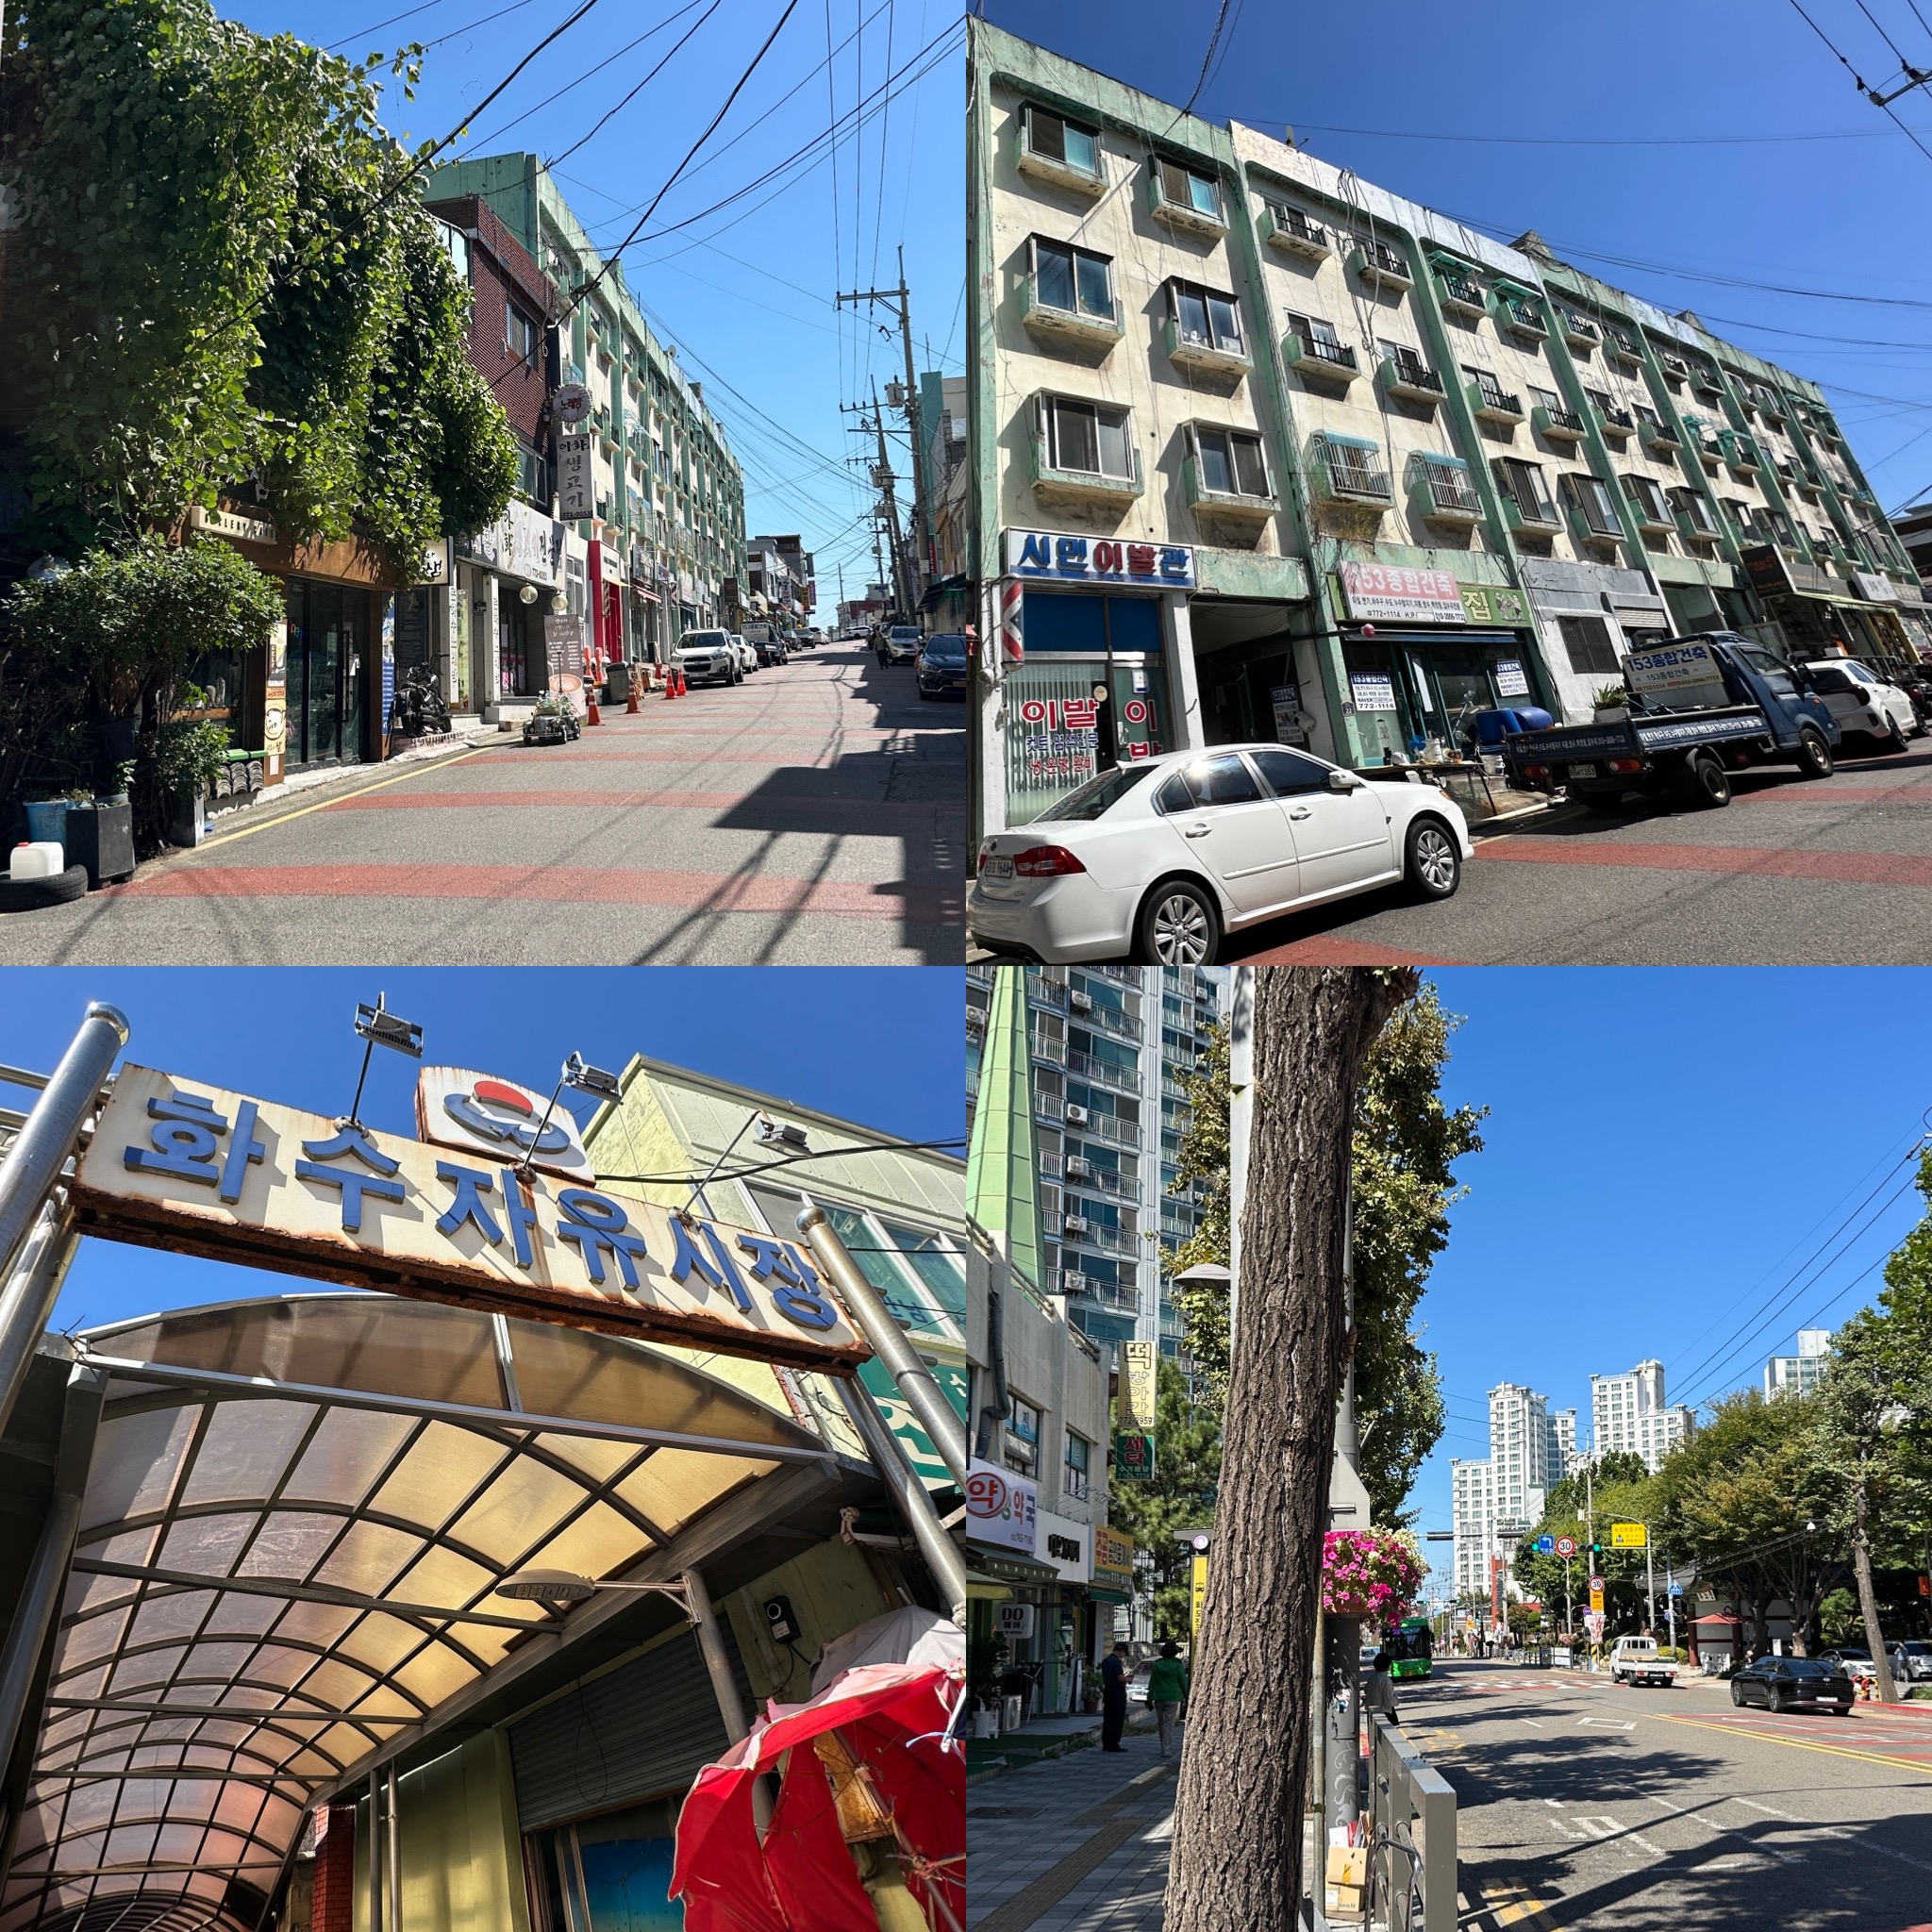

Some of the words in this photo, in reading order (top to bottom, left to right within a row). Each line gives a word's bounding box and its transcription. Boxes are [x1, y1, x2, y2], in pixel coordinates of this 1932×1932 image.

[560, 396, 582, 410] 노래방
[566, 454, 584, 508] 생고기
[1018, 534, 1190, 579] 시민이발관
[1352, 567, 1454, 597] 153종합건축
[1461, 590, 1494, 622] 집
[1625, 645, 1708, 673] 153종합건축
[1353, 674, 1389, 683] 153종합건축
[1646, 667, 1690, 682] 153종합건축
[1021, 698, 1101, 731] 이발
[124, 1089, 839, 1330] 화수자유시장
[1124, 1342, 1152, 1370] 떡
[1119, 1416, 1153, 1424] 772-2959
[1123, 1436, 1147, 1465] 세탁
[968, 1479, 998, 1509] 약
[1559, 1541, 1572, 1551] 30
[1592, 1579, 1601, 1589] 30
[1001, 1607, 1024, 1621] DO
